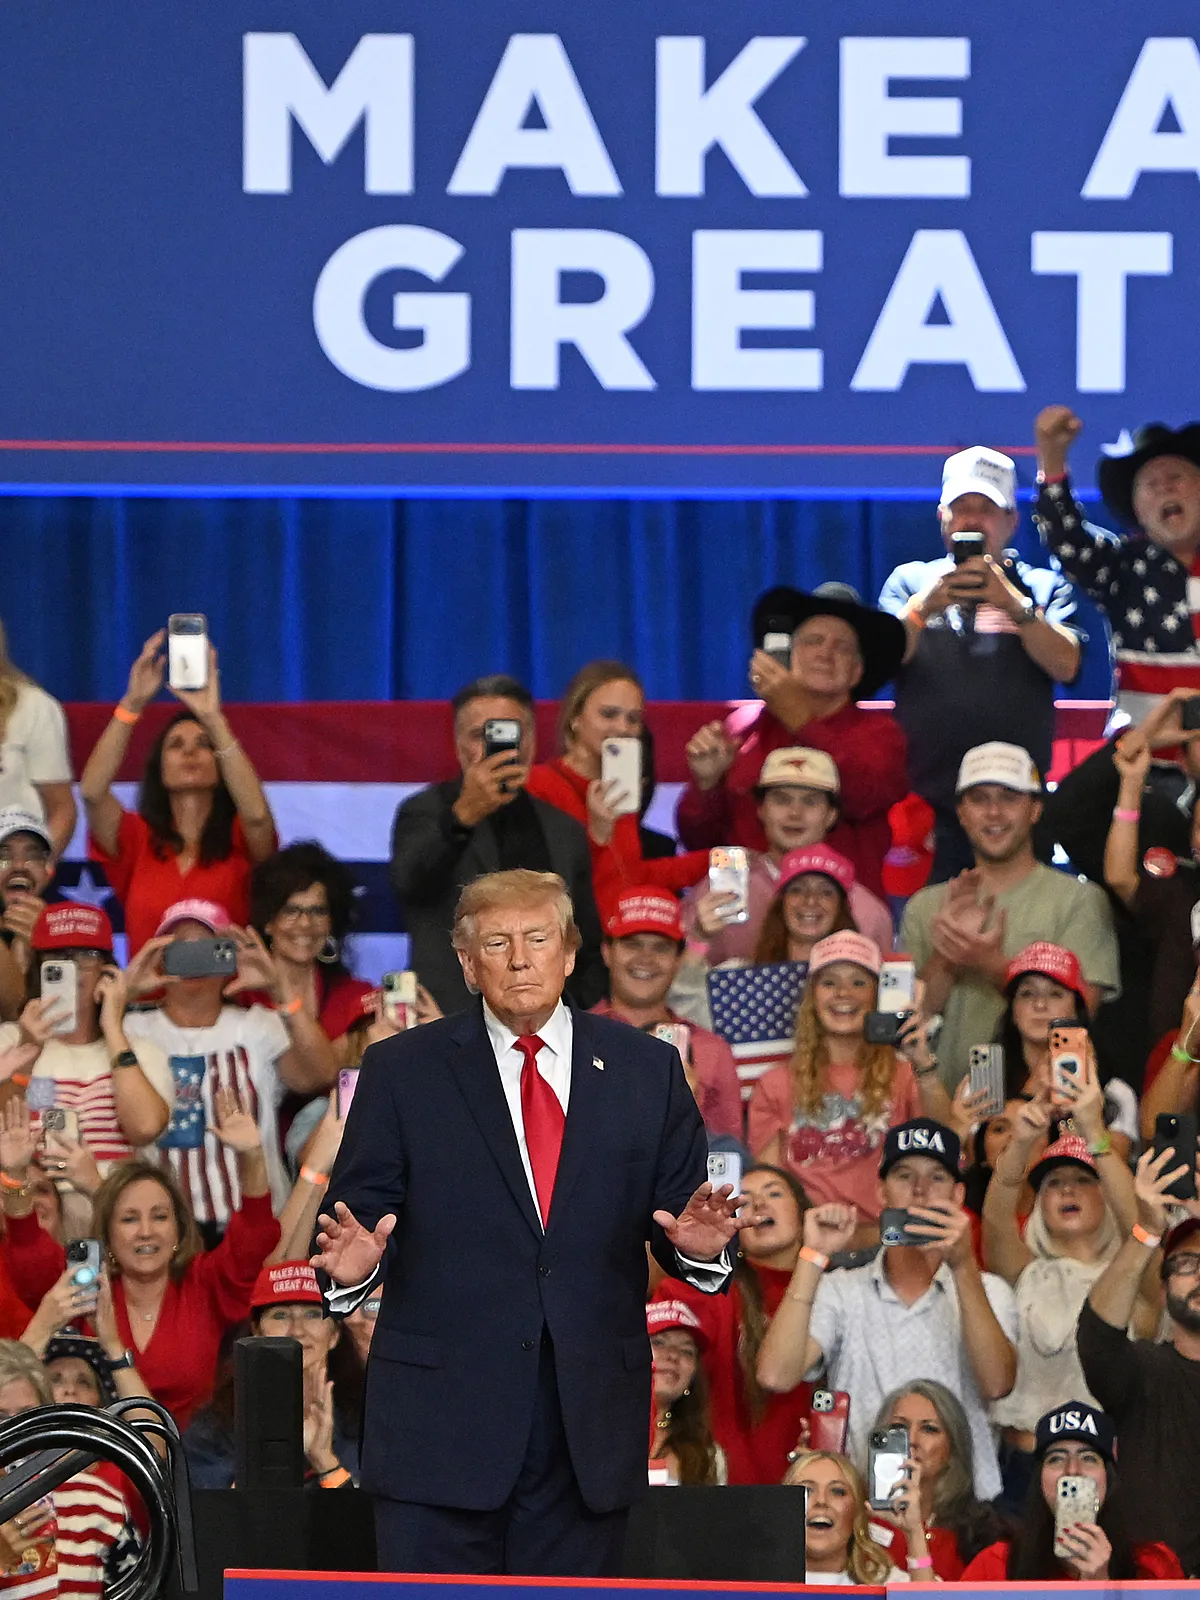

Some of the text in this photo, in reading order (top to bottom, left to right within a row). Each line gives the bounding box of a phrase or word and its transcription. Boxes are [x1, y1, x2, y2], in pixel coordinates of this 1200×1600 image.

[243, 33, 970, 197] MAKE
[314, 224, 1172, 392] GREAT
[897, 1128, 946, 1154] USA
[273, 1277, 321, 1294] GREAT AGA
[1049, 1410, 1099, 1437] USA
